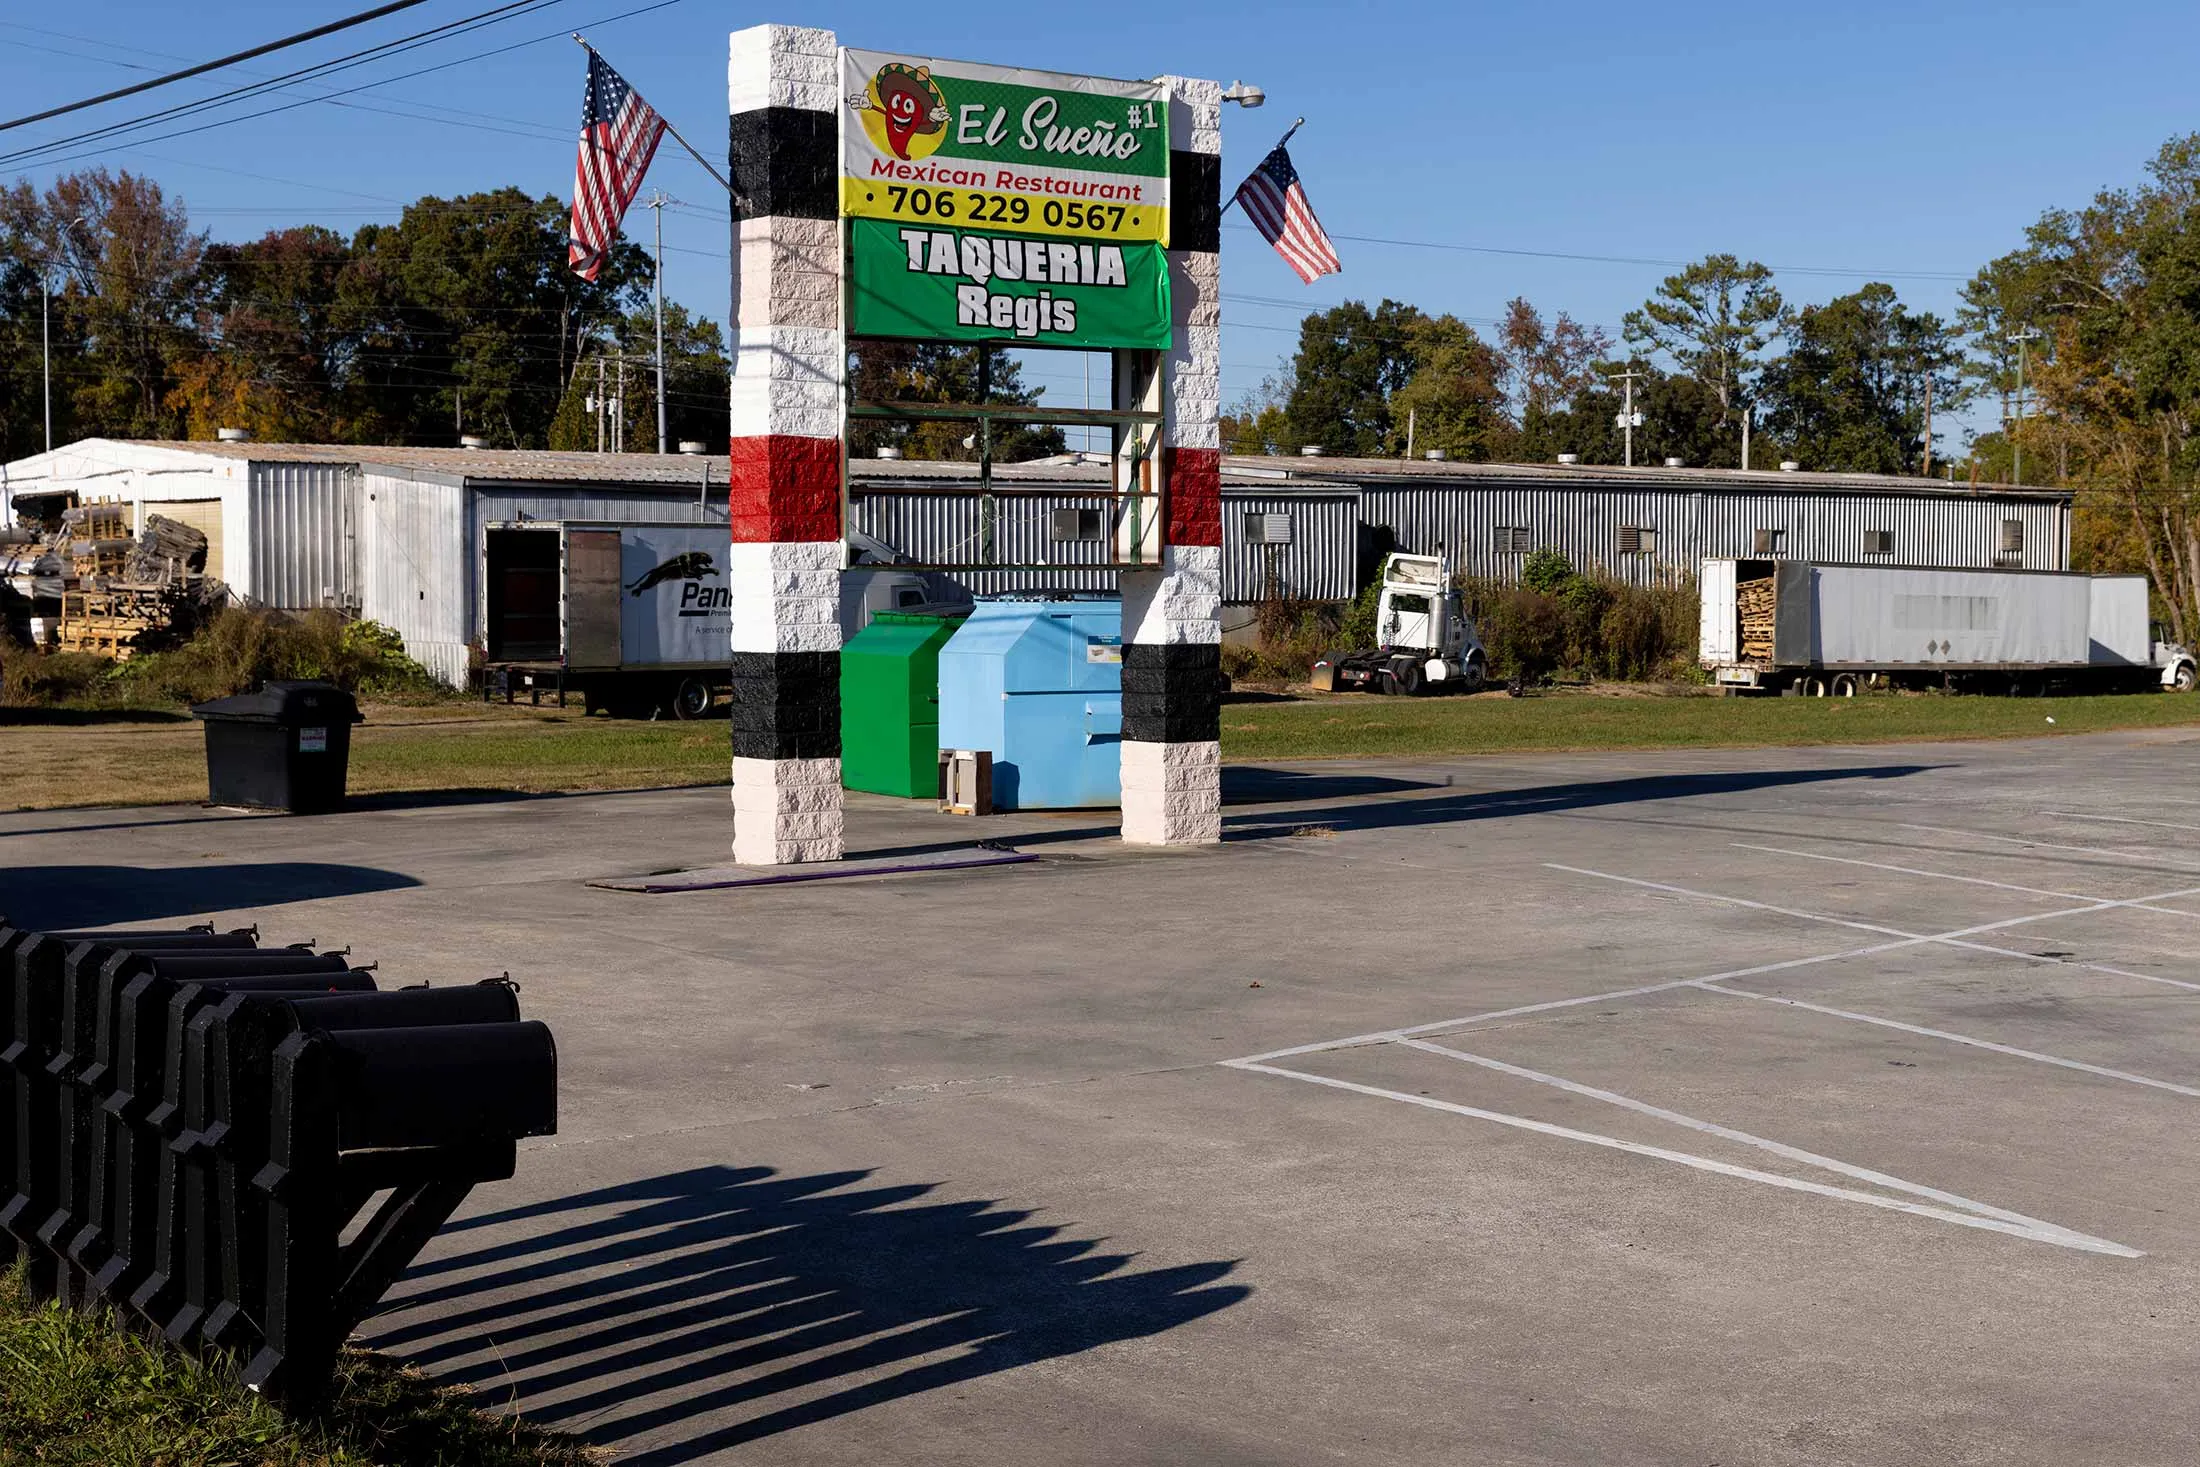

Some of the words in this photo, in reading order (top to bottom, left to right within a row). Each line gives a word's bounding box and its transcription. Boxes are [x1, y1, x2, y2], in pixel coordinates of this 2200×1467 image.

[957, 104, 1009, 147] El
[1018, 96, 1141, 160] Sueño
[1127, 102, 1158, 129] #1
[870, 158, 986, 187] Mexican
[995, 170, 1142, 201] Restaurant
[887, 185, 955, 218] 706
[967, 193, 1030, 224] 229
[1043, 200, 1126, 232] 0567
[900, 229, 1127, 287] TAQUERIA
[957, 284, 1077, 338] Regis
